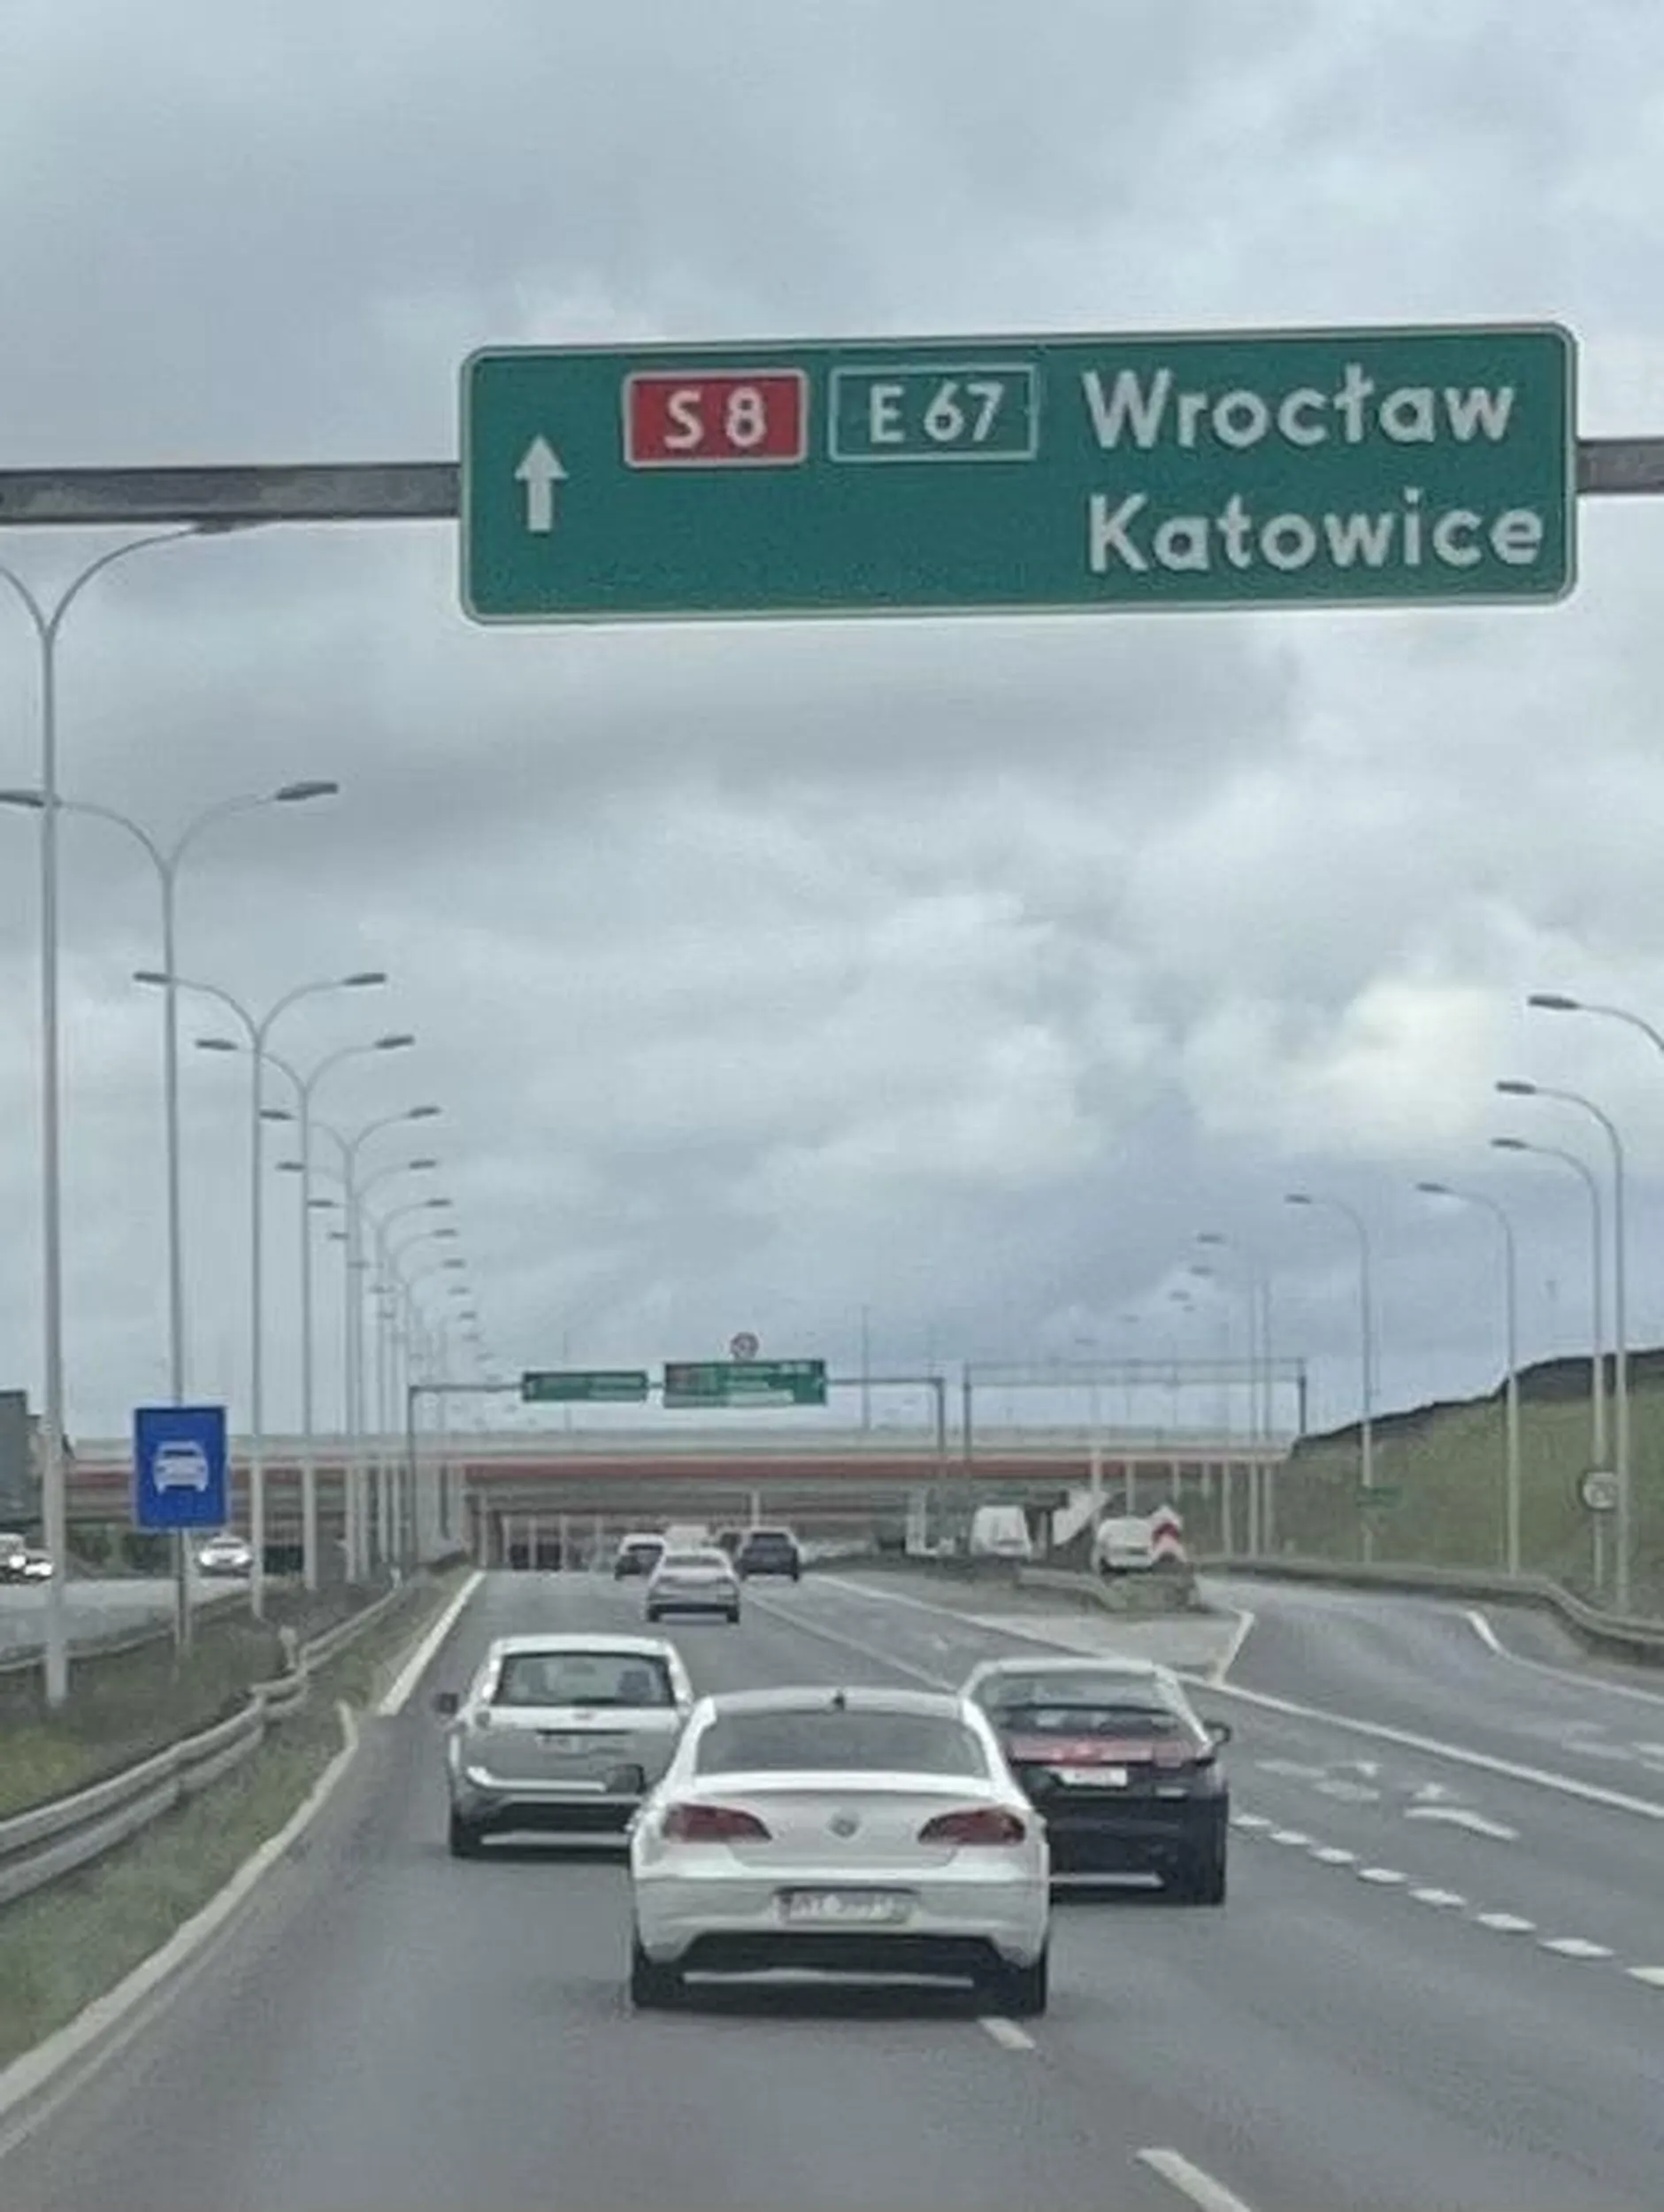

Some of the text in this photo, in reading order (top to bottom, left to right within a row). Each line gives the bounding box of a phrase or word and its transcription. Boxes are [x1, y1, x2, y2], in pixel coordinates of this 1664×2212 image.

[664, 387, 766, 449] S 8
[871, 383, 1002, 442] E 67
[1085, 366, 1513, 447] Wrocław
[1092, 488, 1543, 571] Katowice
